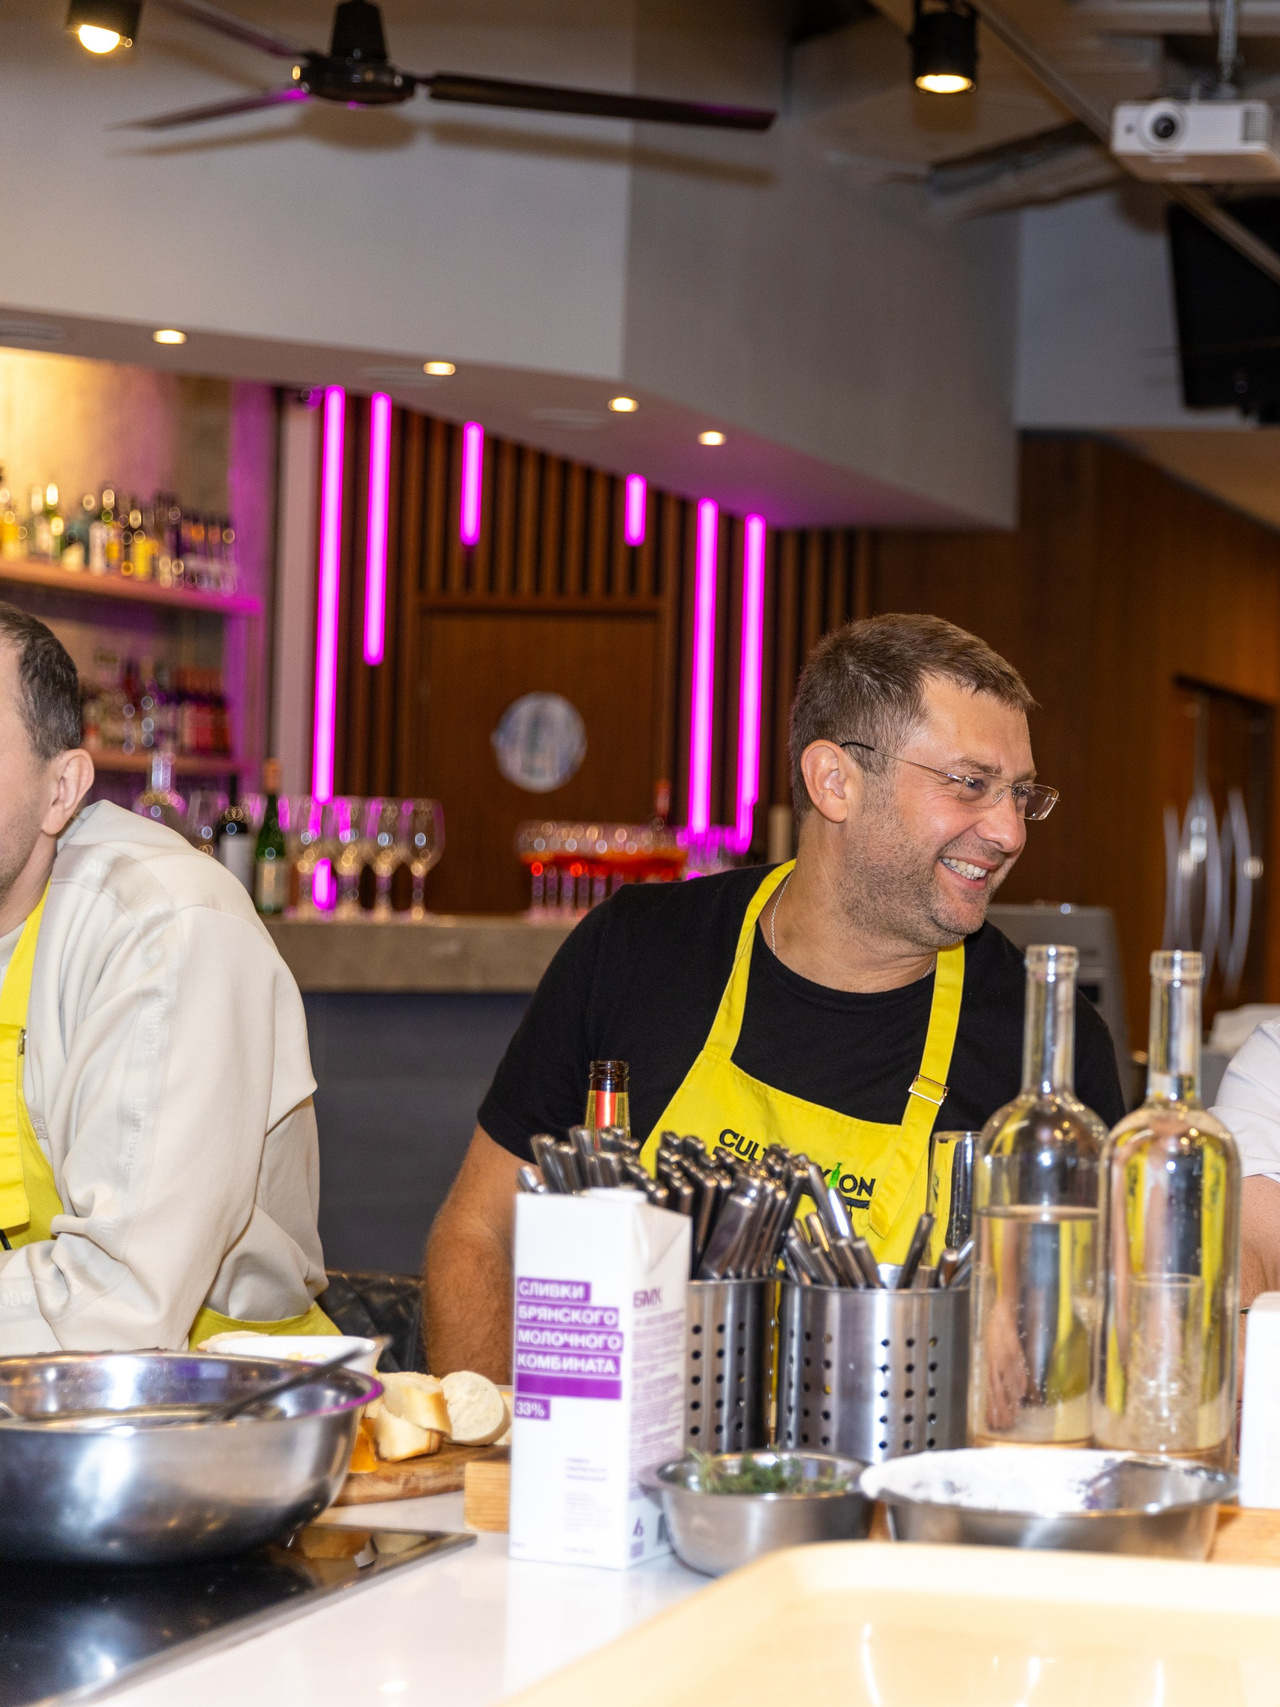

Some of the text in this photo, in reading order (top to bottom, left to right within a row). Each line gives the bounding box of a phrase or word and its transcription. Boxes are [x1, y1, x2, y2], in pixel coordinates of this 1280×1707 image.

[519, 1281, 584, 1299] СЛИВКИ
[519, 1305, 617, 1326] БРЯНСКОГО
[518, 1329, 621, 1350] МОЛОЧНОГО
[517, 1353, 616, 1374] КОМБИНАТА
[515, 1401, 545, 1418] 33%
